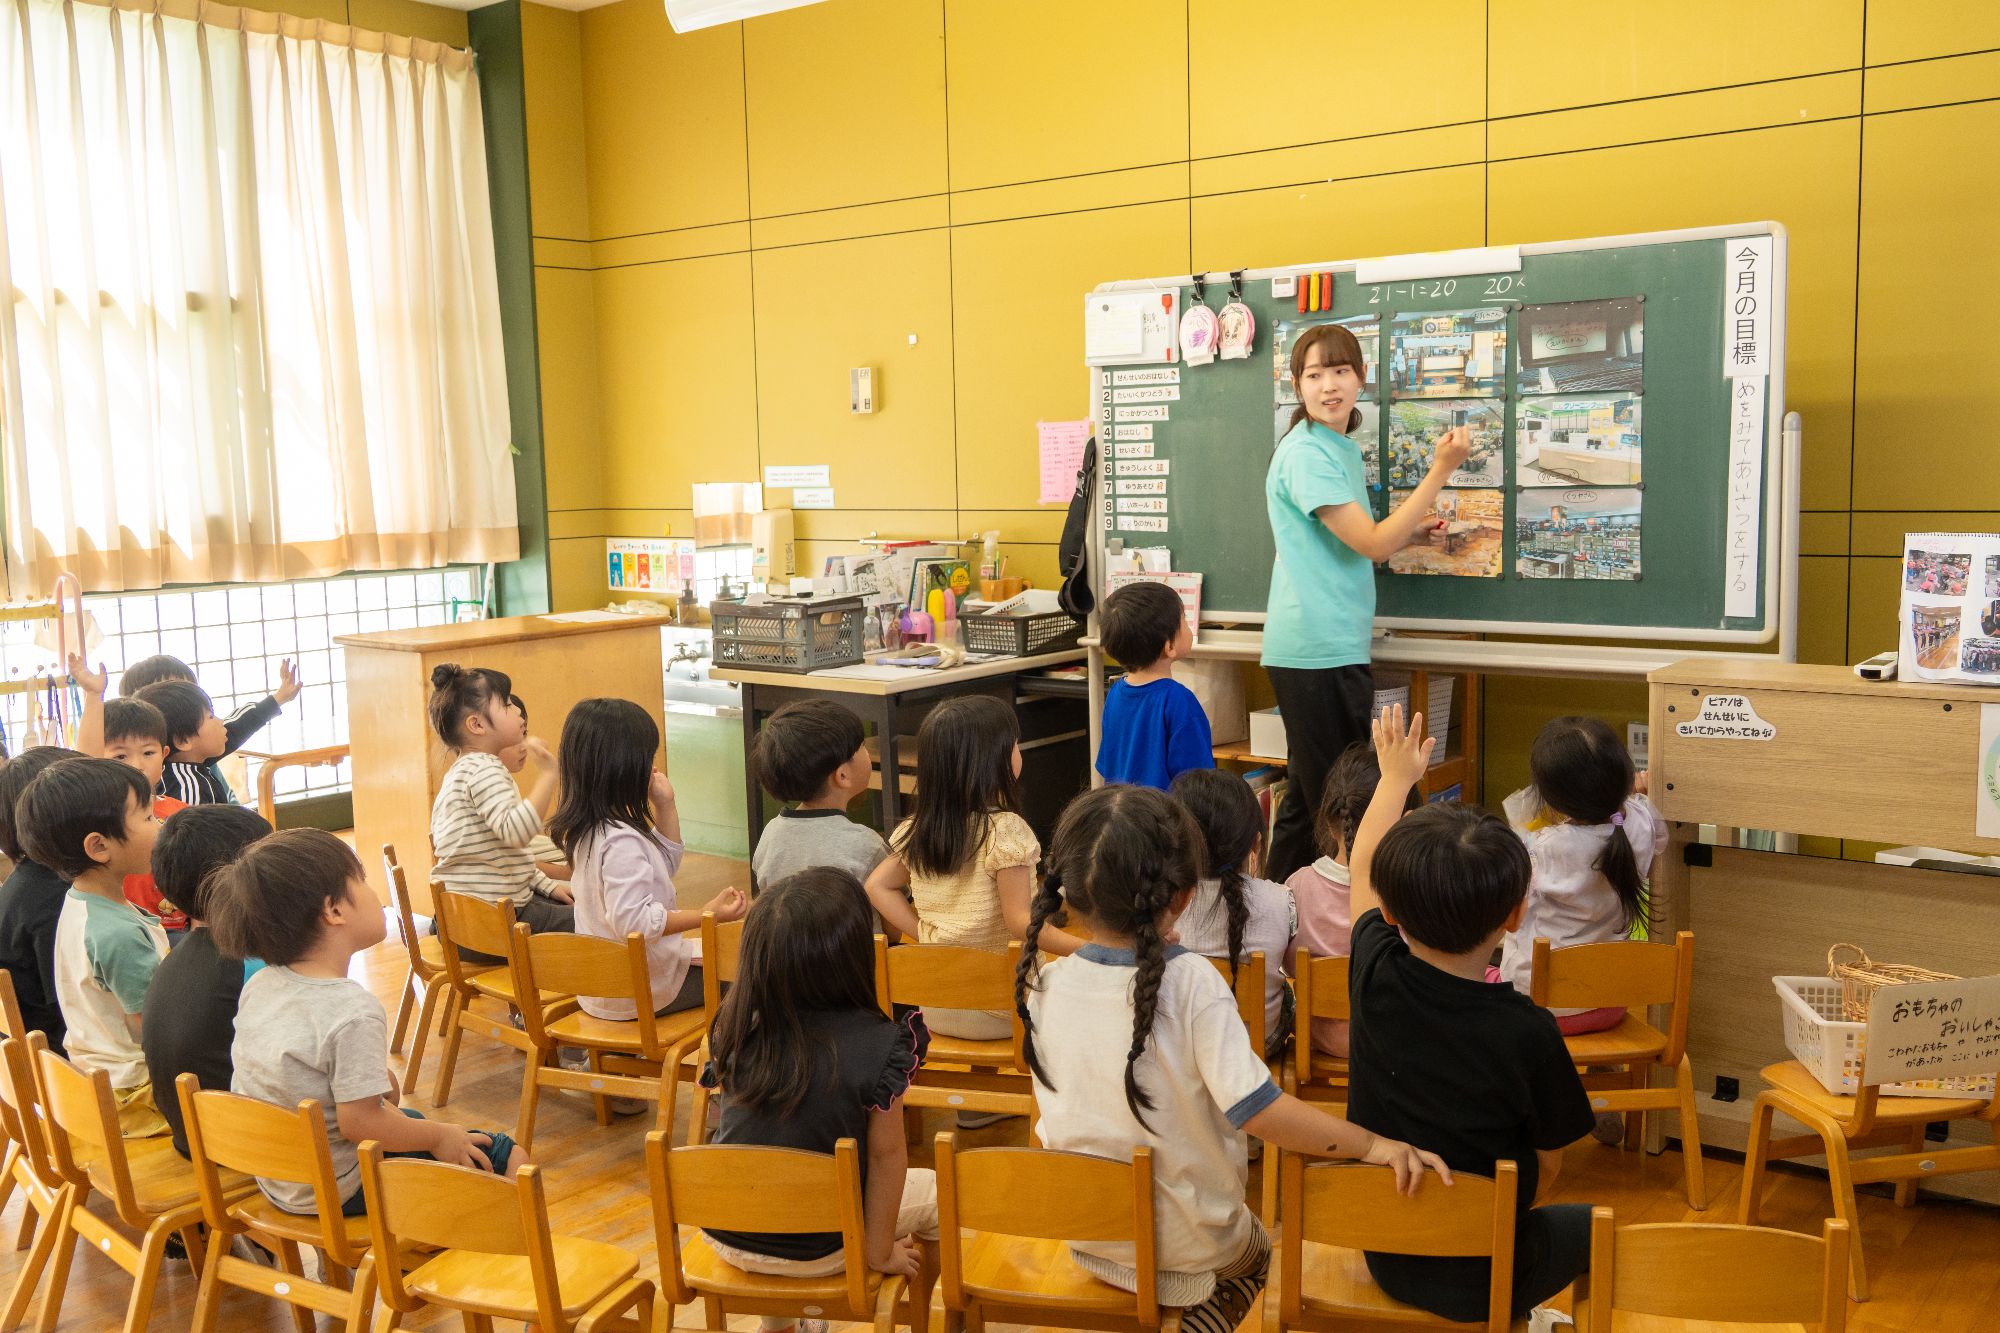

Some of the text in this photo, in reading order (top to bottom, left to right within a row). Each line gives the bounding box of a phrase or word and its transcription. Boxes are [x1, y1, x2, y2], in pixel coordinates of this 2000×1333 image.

[1369, 279, 1457, 304] 21-1=20
[1733, 246, 1759, 365] 今月の目標
[1104, 373, 1168, 385] 1 せんせいのおはなし
[1103, 391, 1110, 402] 2
[1103, 409, 1111, 420] 3
[1104, 427, 1111, 437] 4
[1104, 445, 1111, 455] 5
[1104, 463, 1112, 474] 6
[1105, 482, 1112, 493] 7
[1732, 381, 1756, 592] めをみてあいさつをする
[1105, 501, 1112, 511] 8
[1105, 518, 1112, 529] 9
[1708, 696, 1744, 707] ピアノは
[1703, 711, 1750, 722] せんせいに
[1680, 725, 1760, 737] きいてからやってね
[1892, 997, 1963, 1022] おもちゃの
